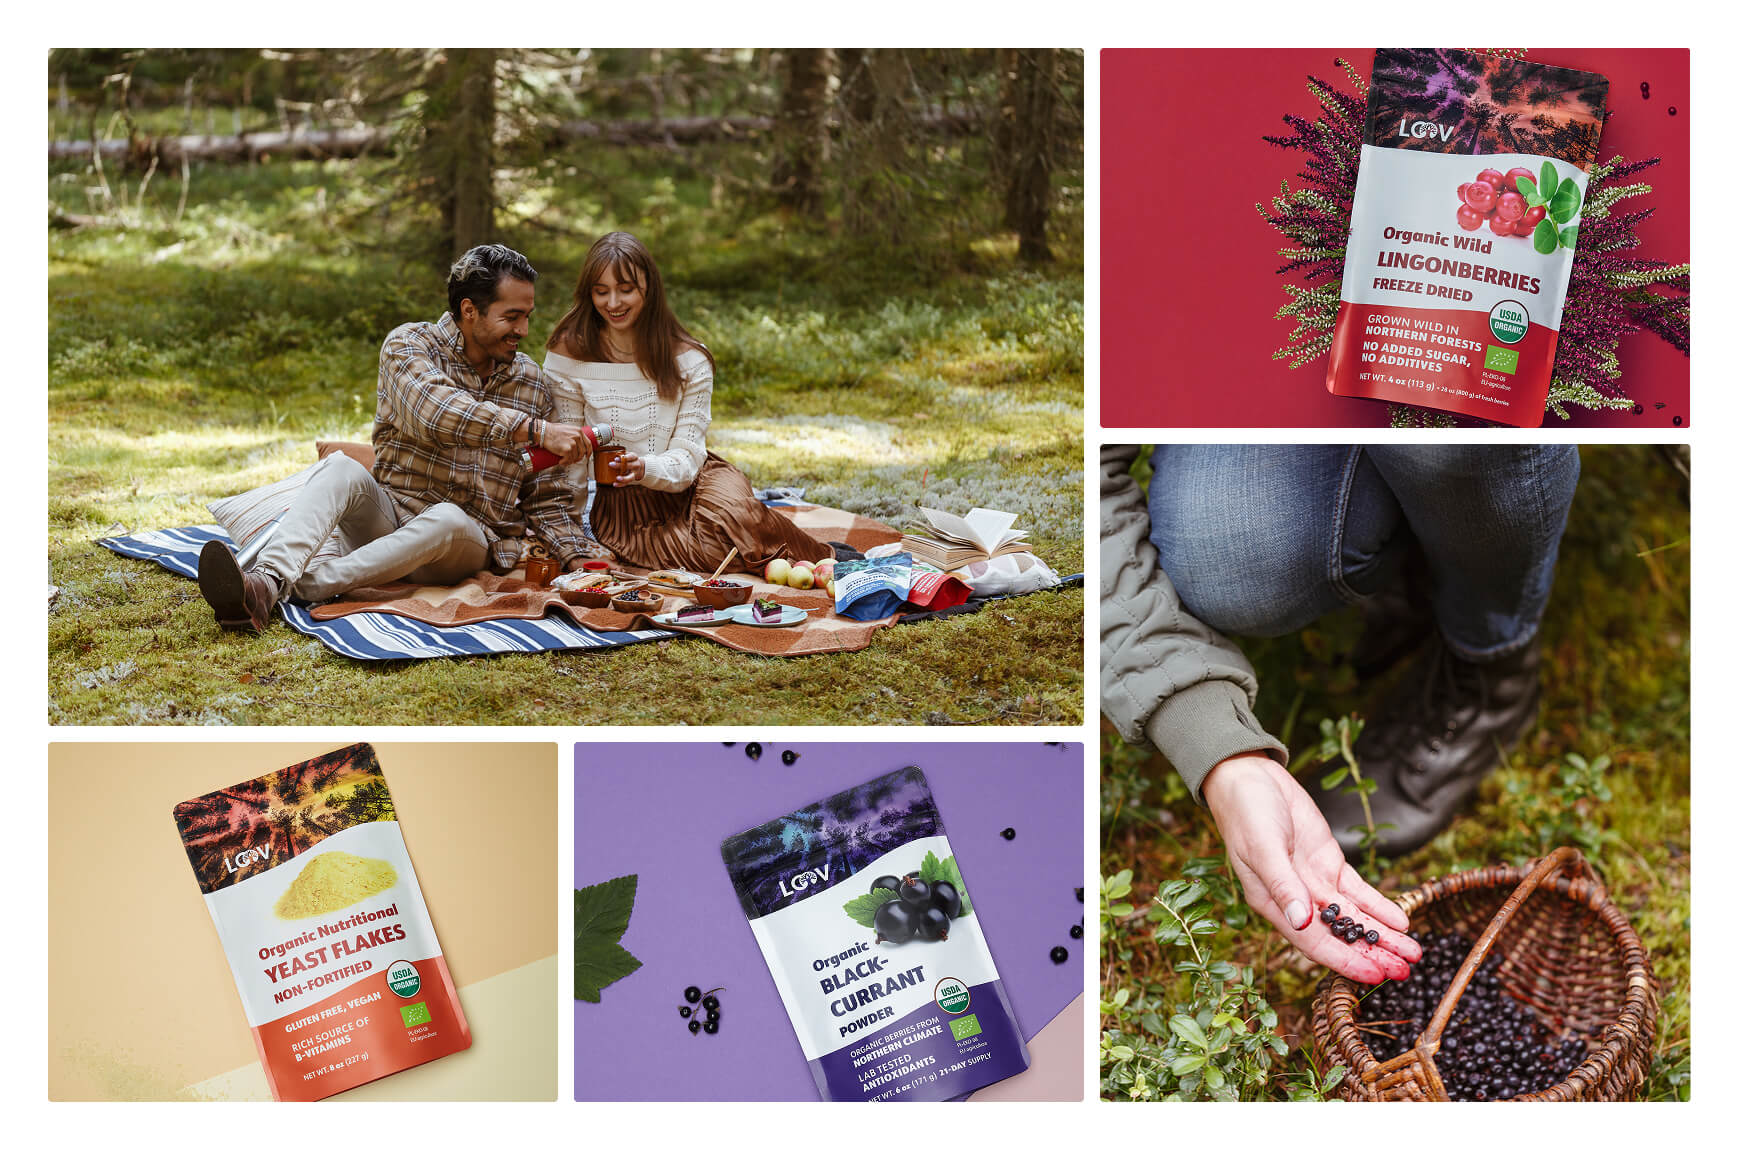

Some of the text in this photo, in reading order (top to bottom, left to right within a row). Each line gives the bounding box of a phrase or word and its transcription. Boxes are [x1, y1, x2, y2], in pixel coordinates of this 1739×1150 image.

[1398, 118, 1454, 142] LOOV
[1384, 226, 1492, 254] Organic Wild
[1377, 251, 1540, 294] LINGONBERRIES
[1373, 278, 1473, 302] FREEZE DRIED
[1368, 314, 1460, 336] GROWN WILD IN
[1494, 322, 1523, 336] ORGANIC
[1500, 309, 1522, 323] USDA
[1366, 326, 1482, 352] NORTHERN FORESTS
[1362, 352, 1443, 372] NO ADDITIVES
[1363, 341, 1471, 368] NO ADDED SUGAR,
[1360, 372, 1370, 381] NET
[1372, 373, 1387, 383] WT.
[1388, 375, 1394, 384] 4
[1408, 378, 1424, 390] (113
[1426, 381, 1435, 392] g)
[224, 844, 270, 874] LOOV
[778, 864, 830, 898] LOOV
[258, 904, 399, 960] Organic Nutritional
[264, 923, 407, 984] YEAST FLAKES
[812, 942, 870, 972] Organic
[274, 960, 373, 1004] NON-FORTIFIED
[392, 968, 413, 981] USDA
[394, 978, 418, 991] ORGANIC
[820, 955, 889, 995] BLACK-
[830, 965, 926, 1018] CURRANT
[941, 984, 961, 998] USDA
[942, 994, 967, 1008] ORGANIC
[286, 992, 382, 1034] GLUTEN FREE, VEGAN
[839, 1006, 895, 1038] POWDER
[292, 1016, 370, 1052] RICH SOURCE OF
[294, 1035, 352, 1062] B-VITAMINS
[850, 1016, 940, 1058] ORGANIC BERRIES FROM
[853, 1025, 944, 1068] NORTHERN CLIMATE
[304, 1072, 316, 1081] NET
[316, 1066, 330, 1076] WT.
[344, 1054, 360, 1068] (227
[361, 1051, 369, 1062] g)
[858, 1054, 912, 1084] LAB TESTED
[862, 1055, 936, 1092] ANTIOXIDANTS
[881, 1090, 896, 1100] WT.
[902, 1084, 912, 1092] oz
[912, 1076, 927, 1089] (171
[928, 1072, 938, 1082] g)
[939, 1062, 966, 1076] 21-DAY
[968, 1052, 992, 1066] SUPPLY
